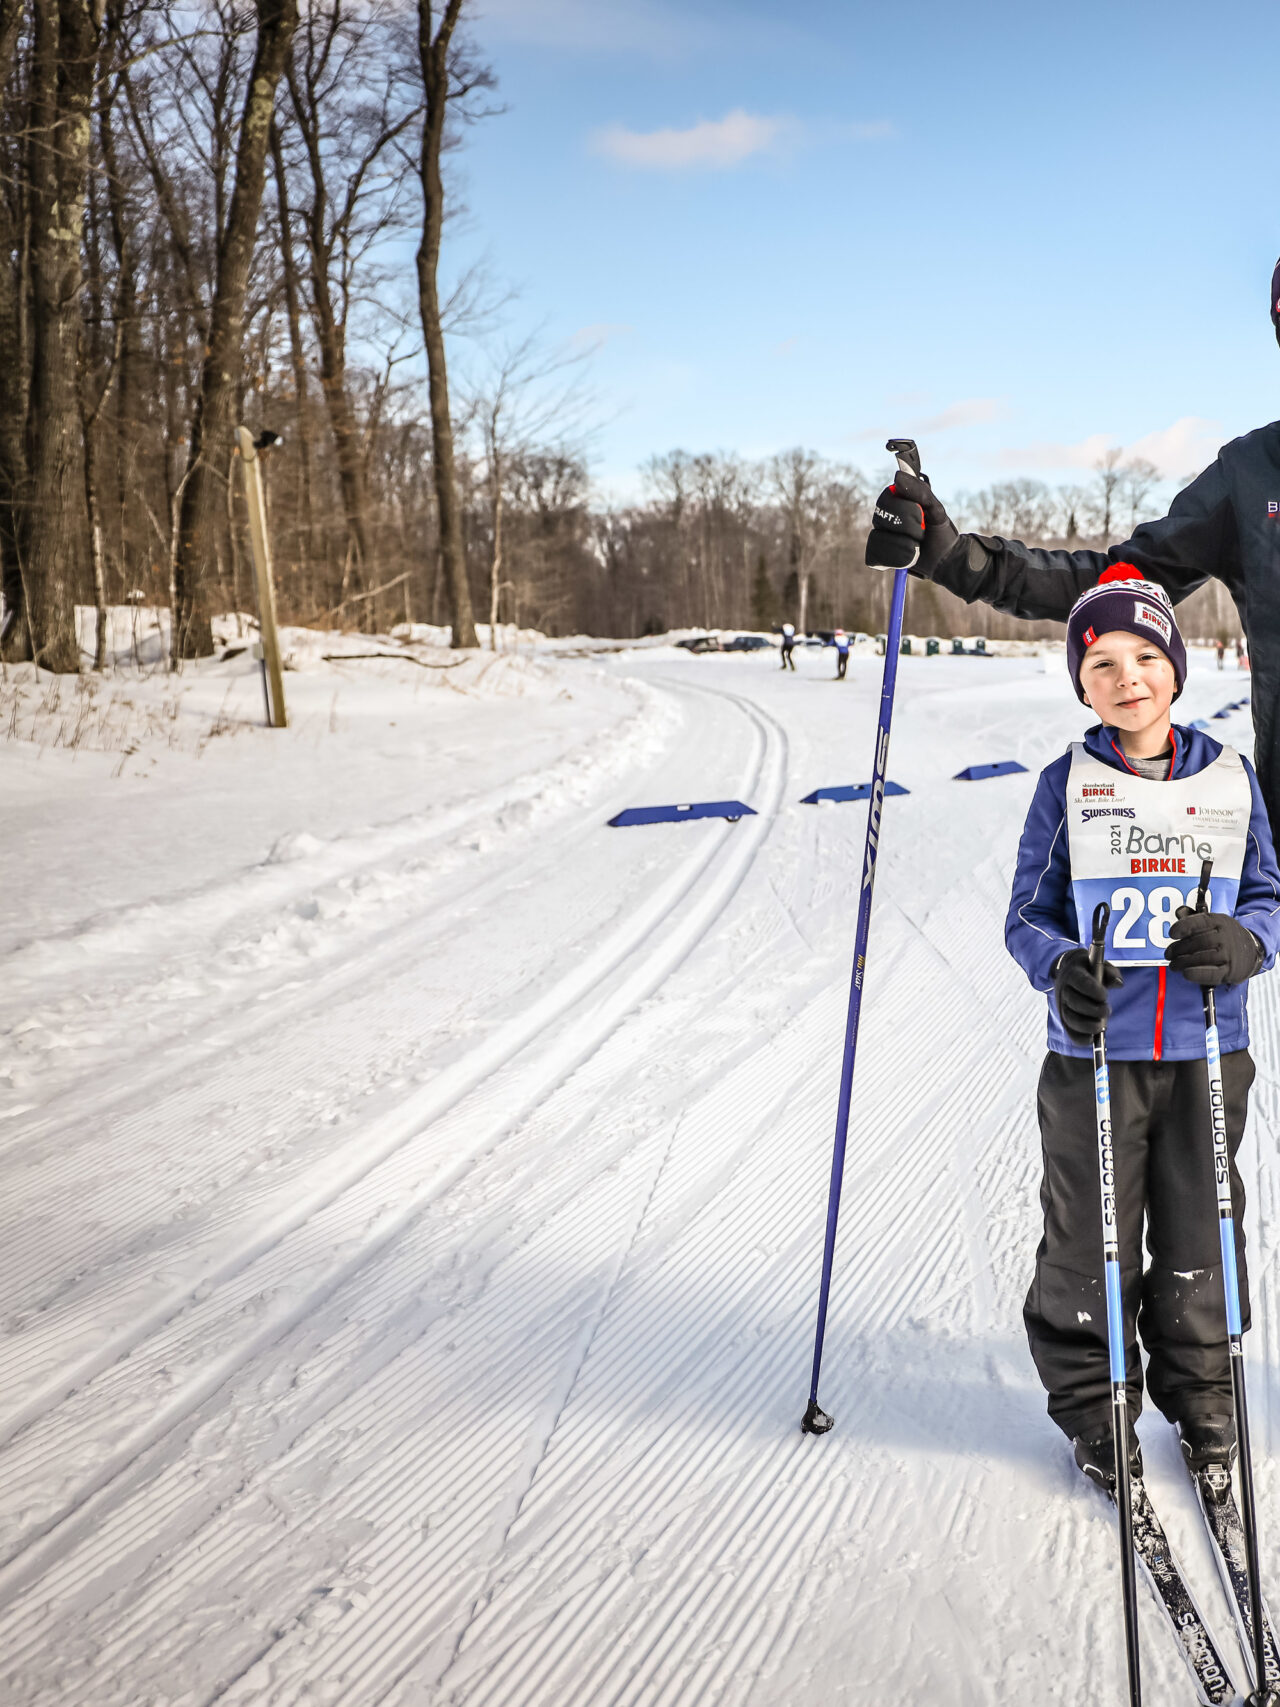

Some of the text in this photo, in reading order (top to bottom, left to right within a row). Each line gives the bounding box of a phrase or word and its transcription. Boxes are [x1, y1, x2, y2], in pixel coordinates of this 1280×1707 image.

[875, 506, 895, 522] RAFT
[1082, 788, 1115, 798] BIRKIE
[1081, 808, 1111, 823] SWISS
[1199, 806, 1234, 817] JOHNSON
[1110, 824, 1122, 855] 2021
[1125, 825, 1213, 861] Barne
[1130, 858, 1186, 875] BIRKIE
[1111, 886, 1212, 949] 28
[1210, 1079, 1229, 1185] salomon
